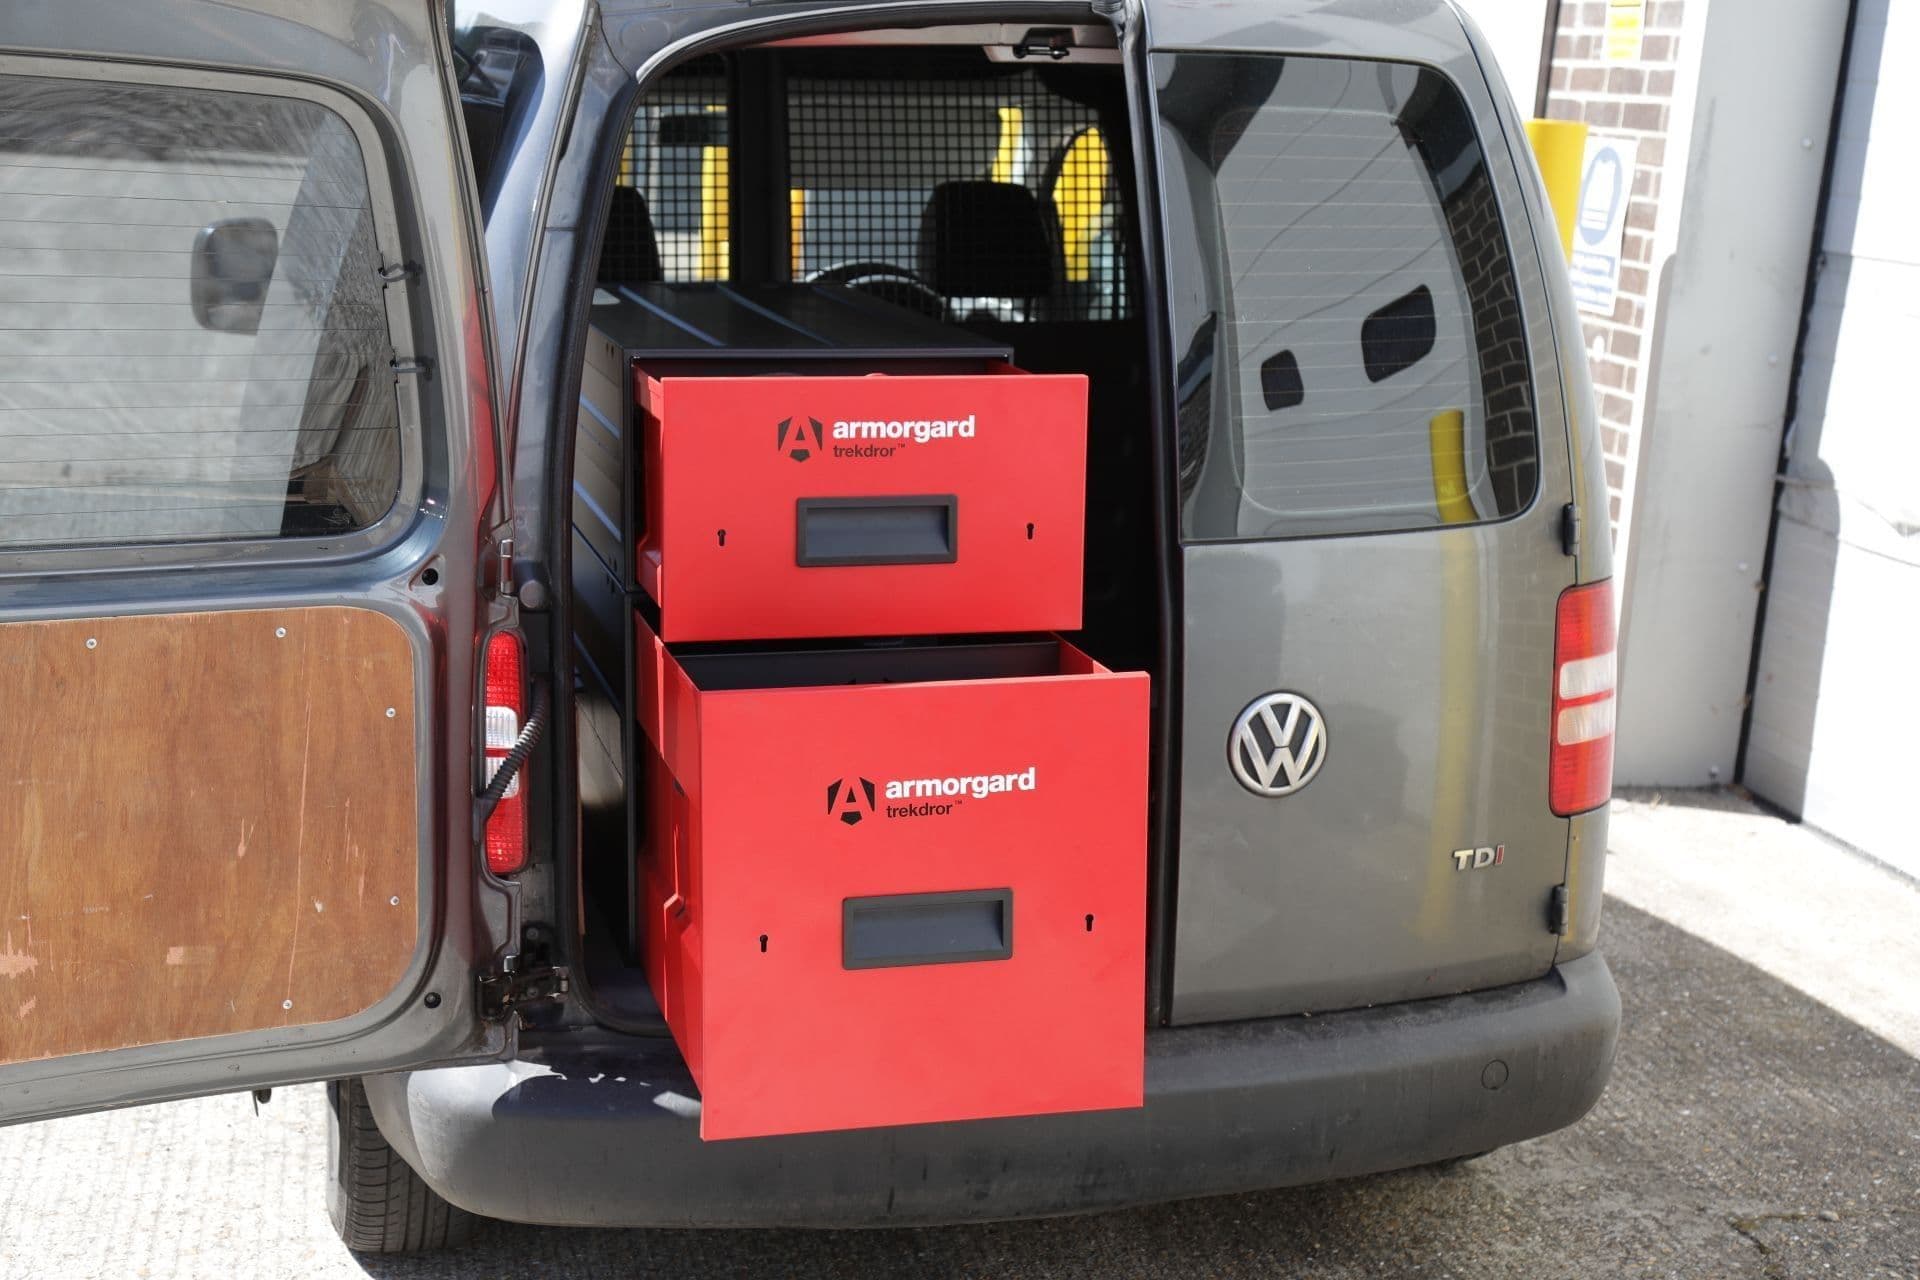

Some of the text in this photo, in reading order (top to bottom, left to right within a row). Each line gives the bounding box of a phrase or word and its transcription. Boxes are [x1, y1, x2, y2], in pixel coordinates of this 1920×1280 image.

[832, 414, 976, 443] armorgard
[885, 767, 1036, 799] armorgard
[1452, 844, 1505, 871] TDI
